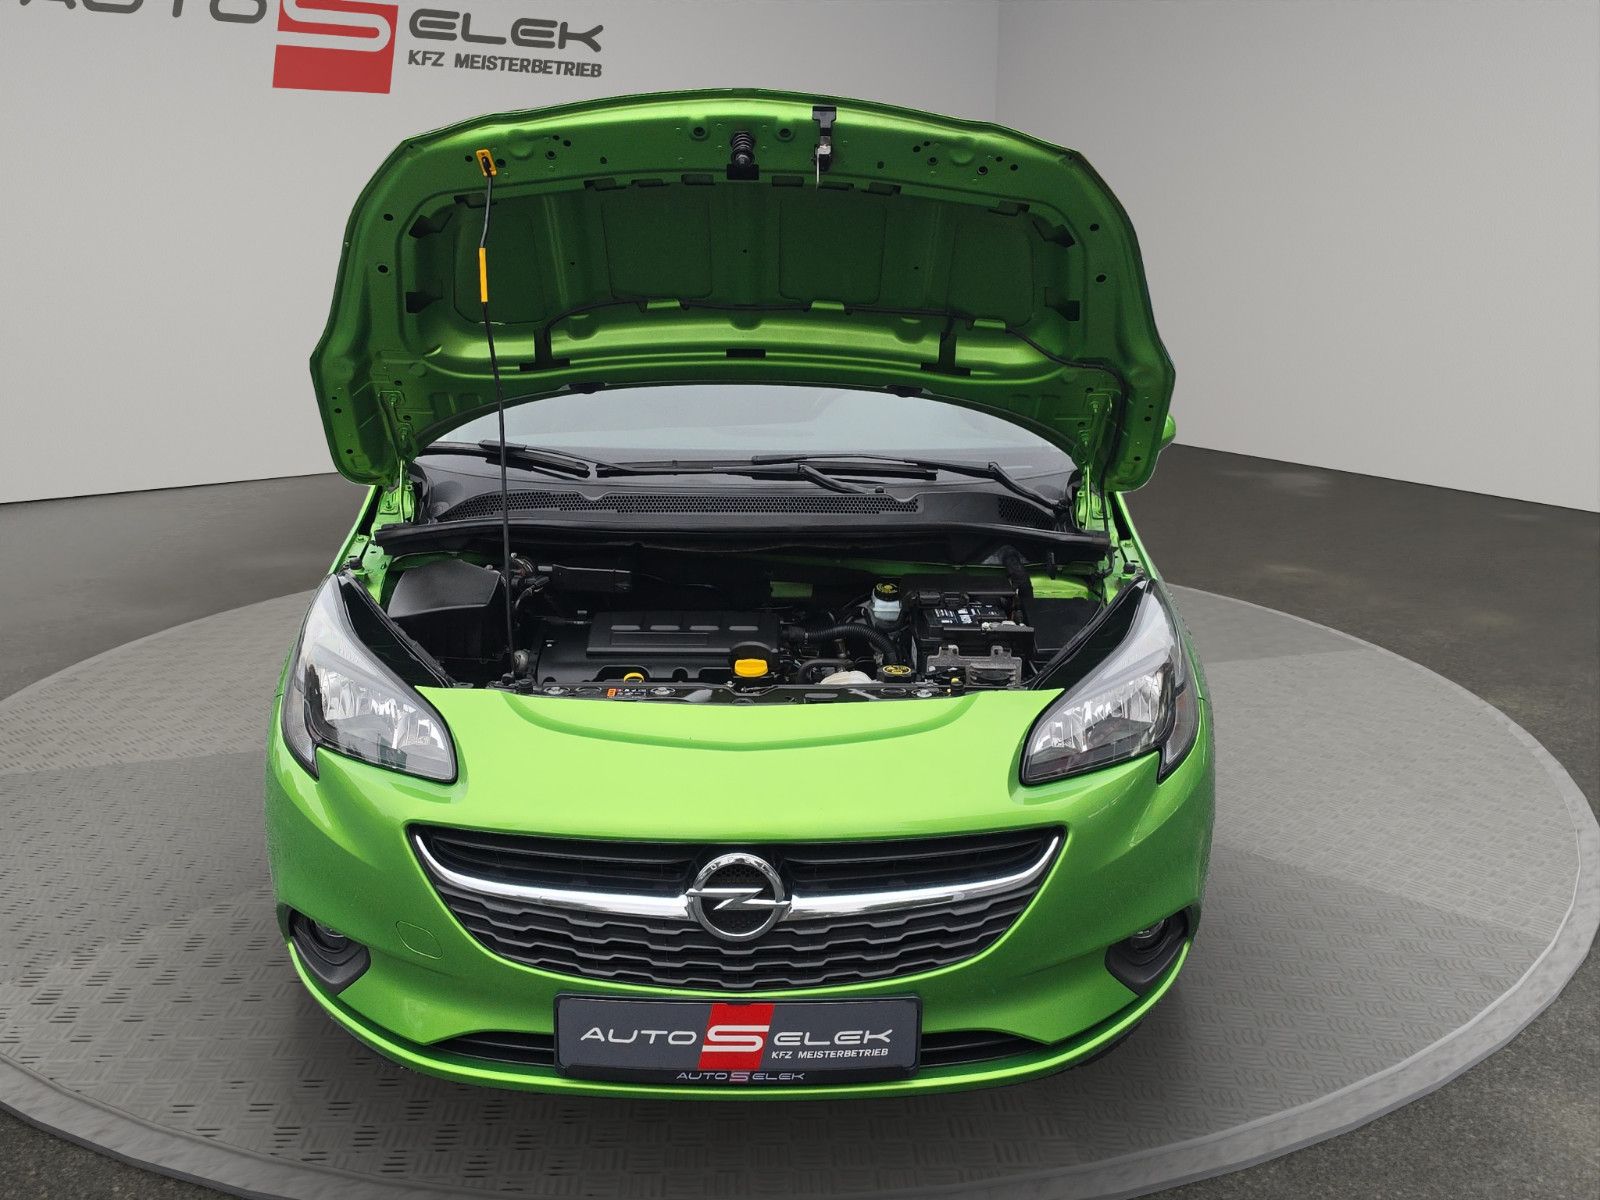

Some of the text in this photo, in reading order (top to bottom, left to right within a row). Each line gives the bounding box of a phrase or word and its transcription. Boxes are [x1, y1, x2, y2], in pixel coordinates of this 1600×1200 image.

[407, 49, 603, 78] KFZ MEISTERBETRIEB
[771, 1047, 889, 1060] KFZ MEISTERBETRIEB
